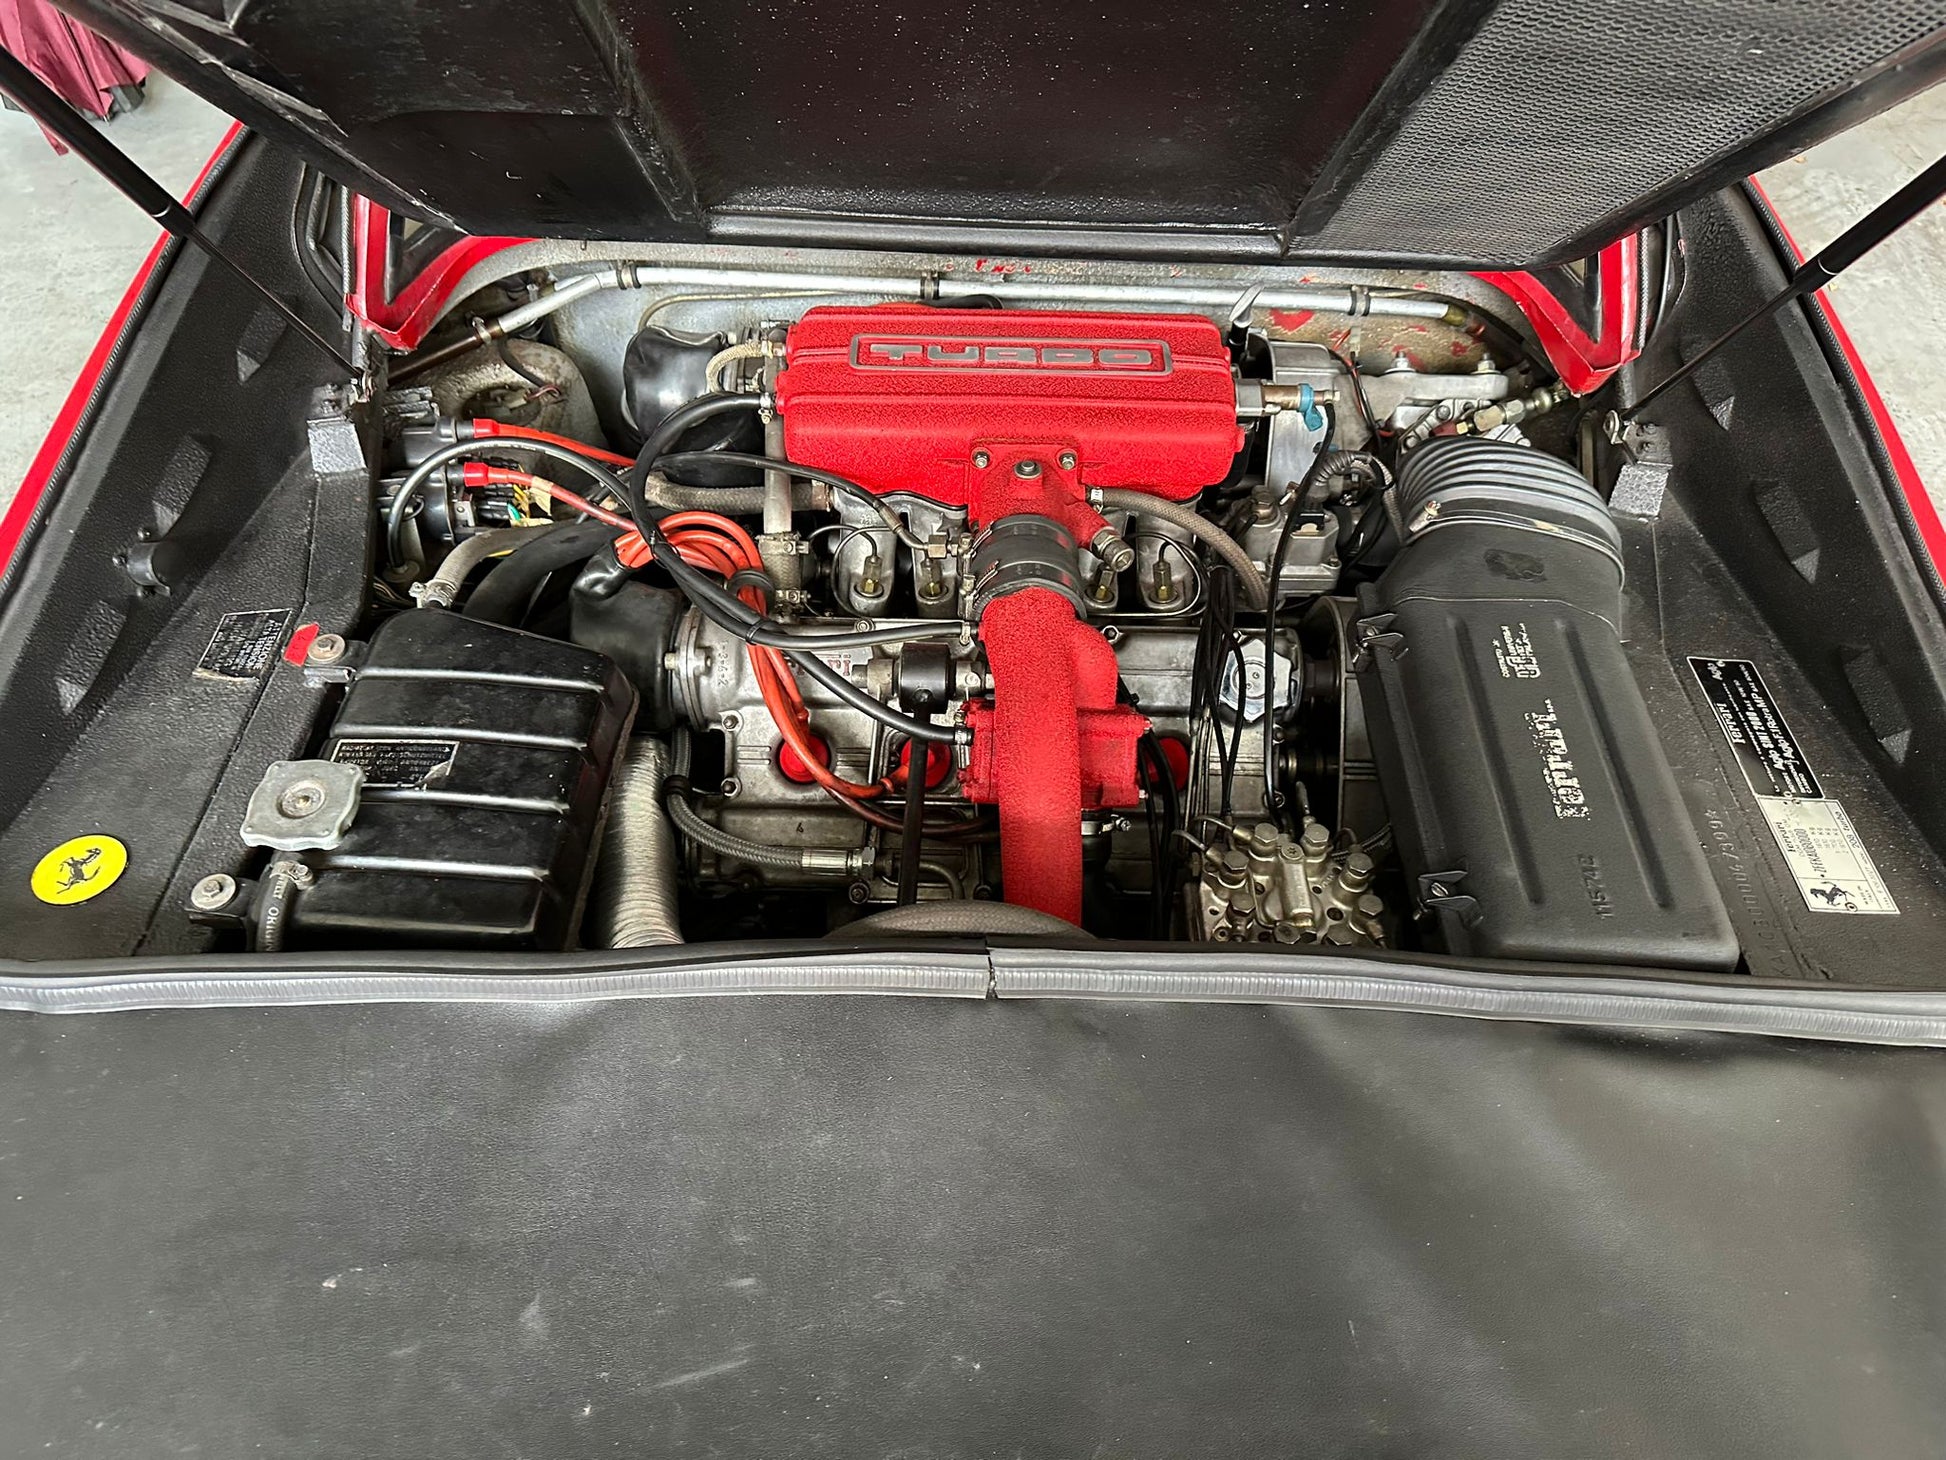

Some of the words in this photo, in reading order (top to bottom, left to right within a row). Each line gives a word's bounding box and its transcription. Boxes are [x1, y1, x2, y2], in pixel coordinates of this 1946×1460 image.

[869, 343, 1152, 365] TURBO
[1751, 693, 1767, 707] MP
[1716, 702, 1745, 743] Ferrari
[1768, 750, 1786, 770] Agip
[1775, 822, 1796, 852] Ferrari
